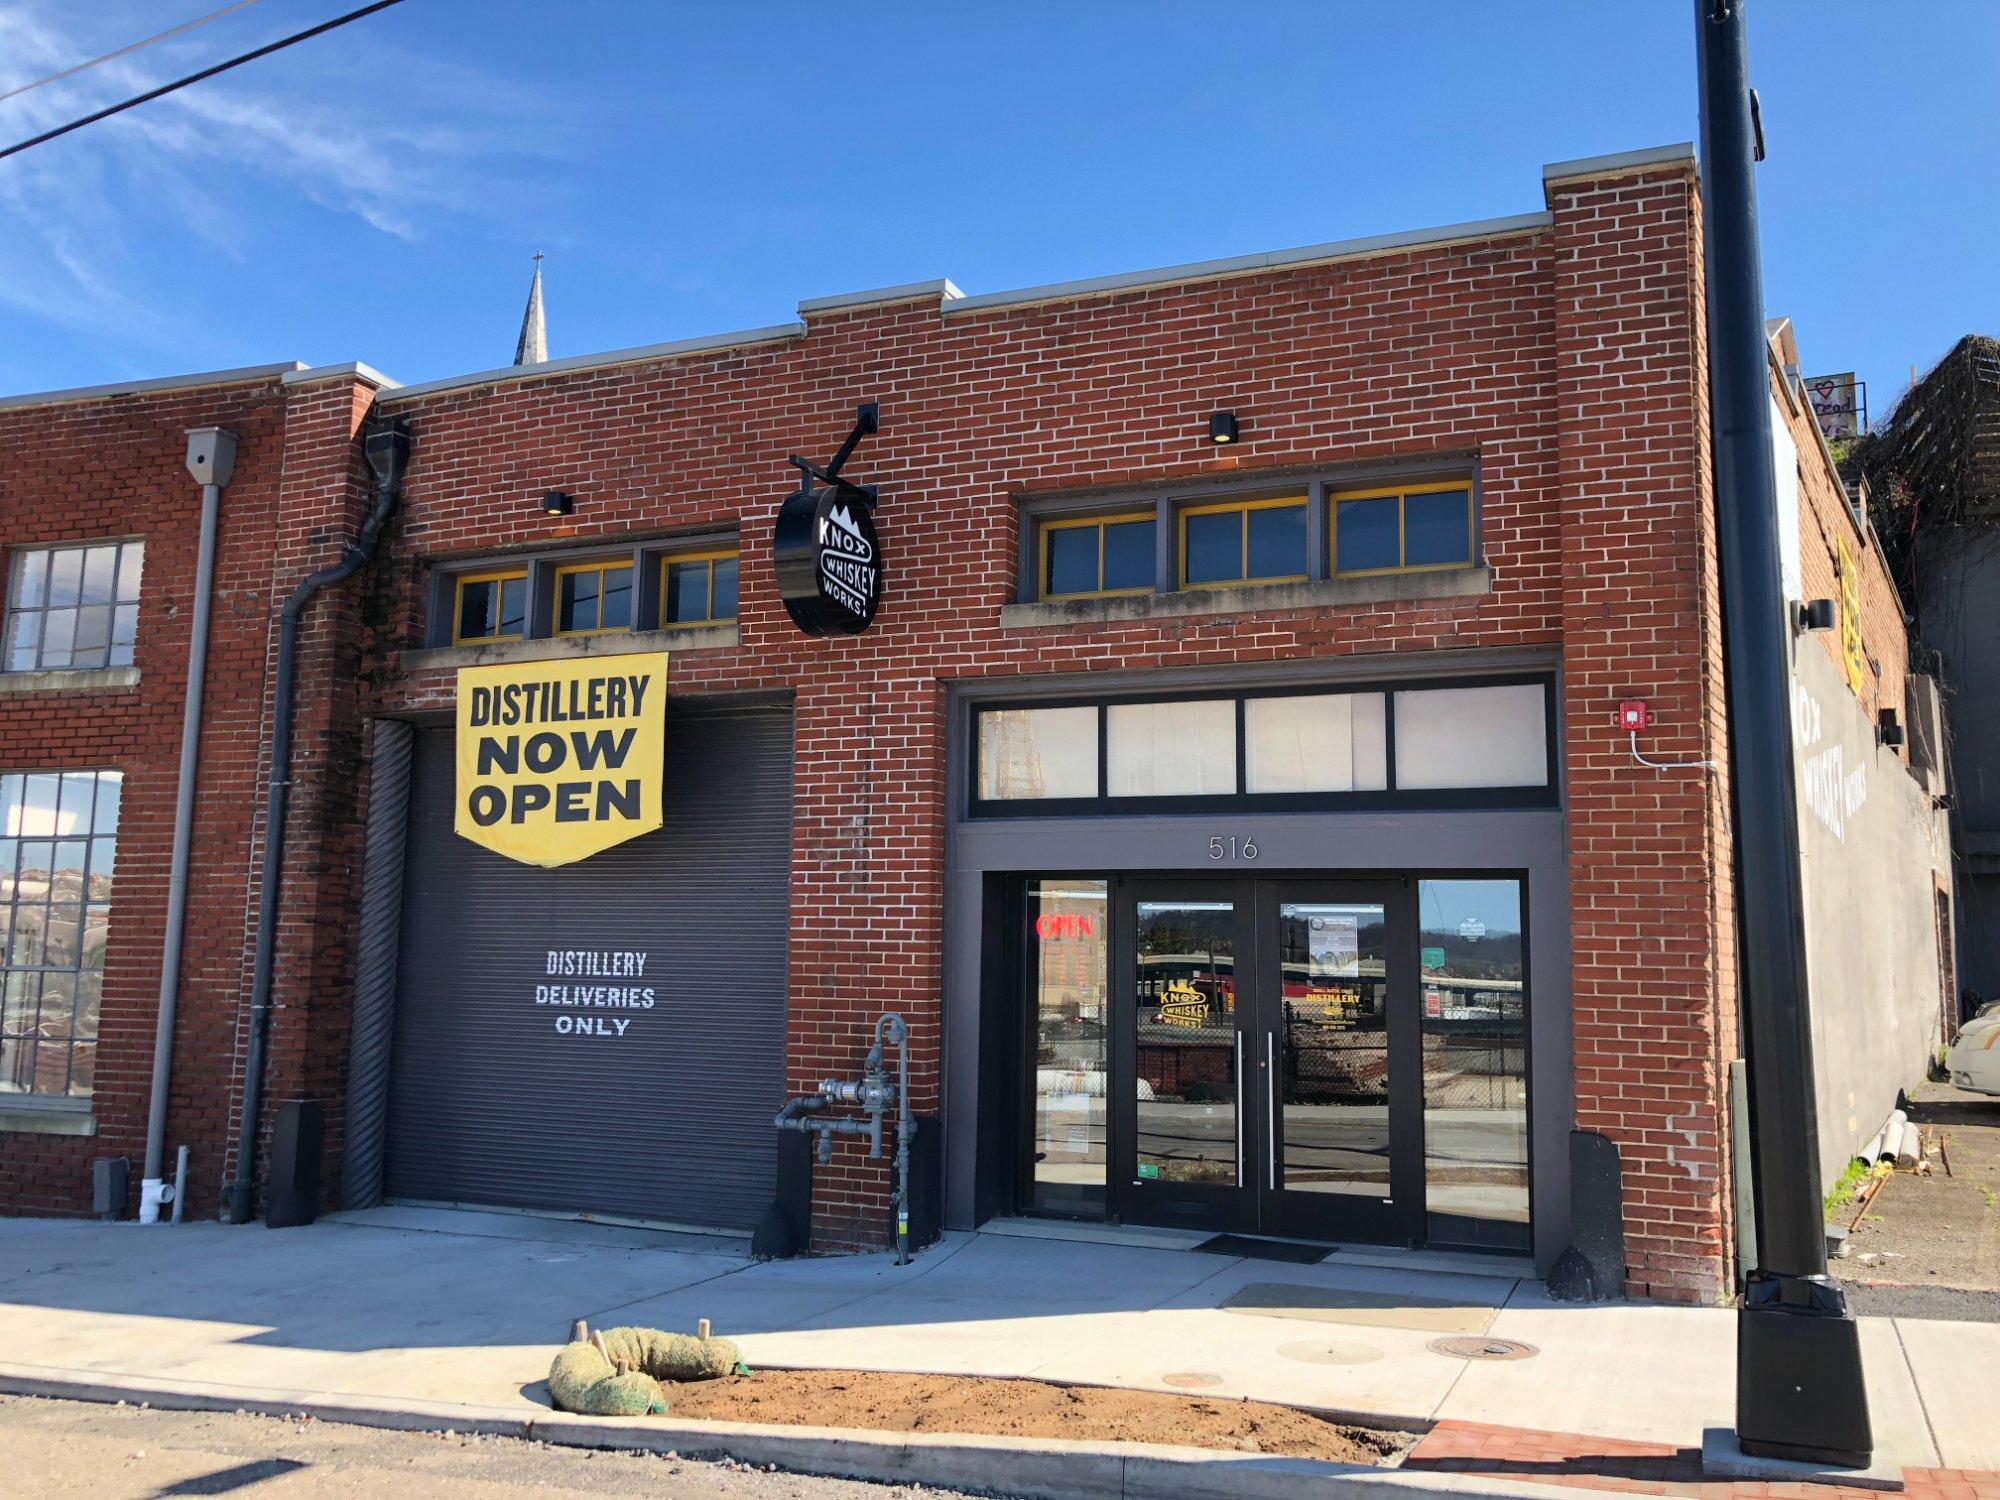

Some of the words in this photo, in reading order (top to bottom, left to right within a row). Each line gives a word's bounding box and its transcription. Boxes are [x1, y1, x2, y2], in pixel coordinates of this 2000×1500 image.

[819, 517, 866, 555] KNOX
[826, 557, 876, 598] WHISKEY
[822, 576, 862, 615] WORKS
[469, 674, 651, 728] DISTILLERY
[475, 727, 638, 776] NOW
[468, 779, 641, 827] OPEN
[1209, 836, 1258, 859] 516
[1036, 913, 1094, 939] OPEN
[546, 950, 647, 977] DISTILLERY
[535, 985, 655, 1008] DELIVERIES
[1160, 991, 1200, 1004] KNOX
[1306, 993, 1360, 1005] DISTILLERY
[1163, 1016, 1197, 1029] WORKS
[1166, 1004, 1210, 1019] WHISKEY
[554, 1016, 631, 1036] ONLY
